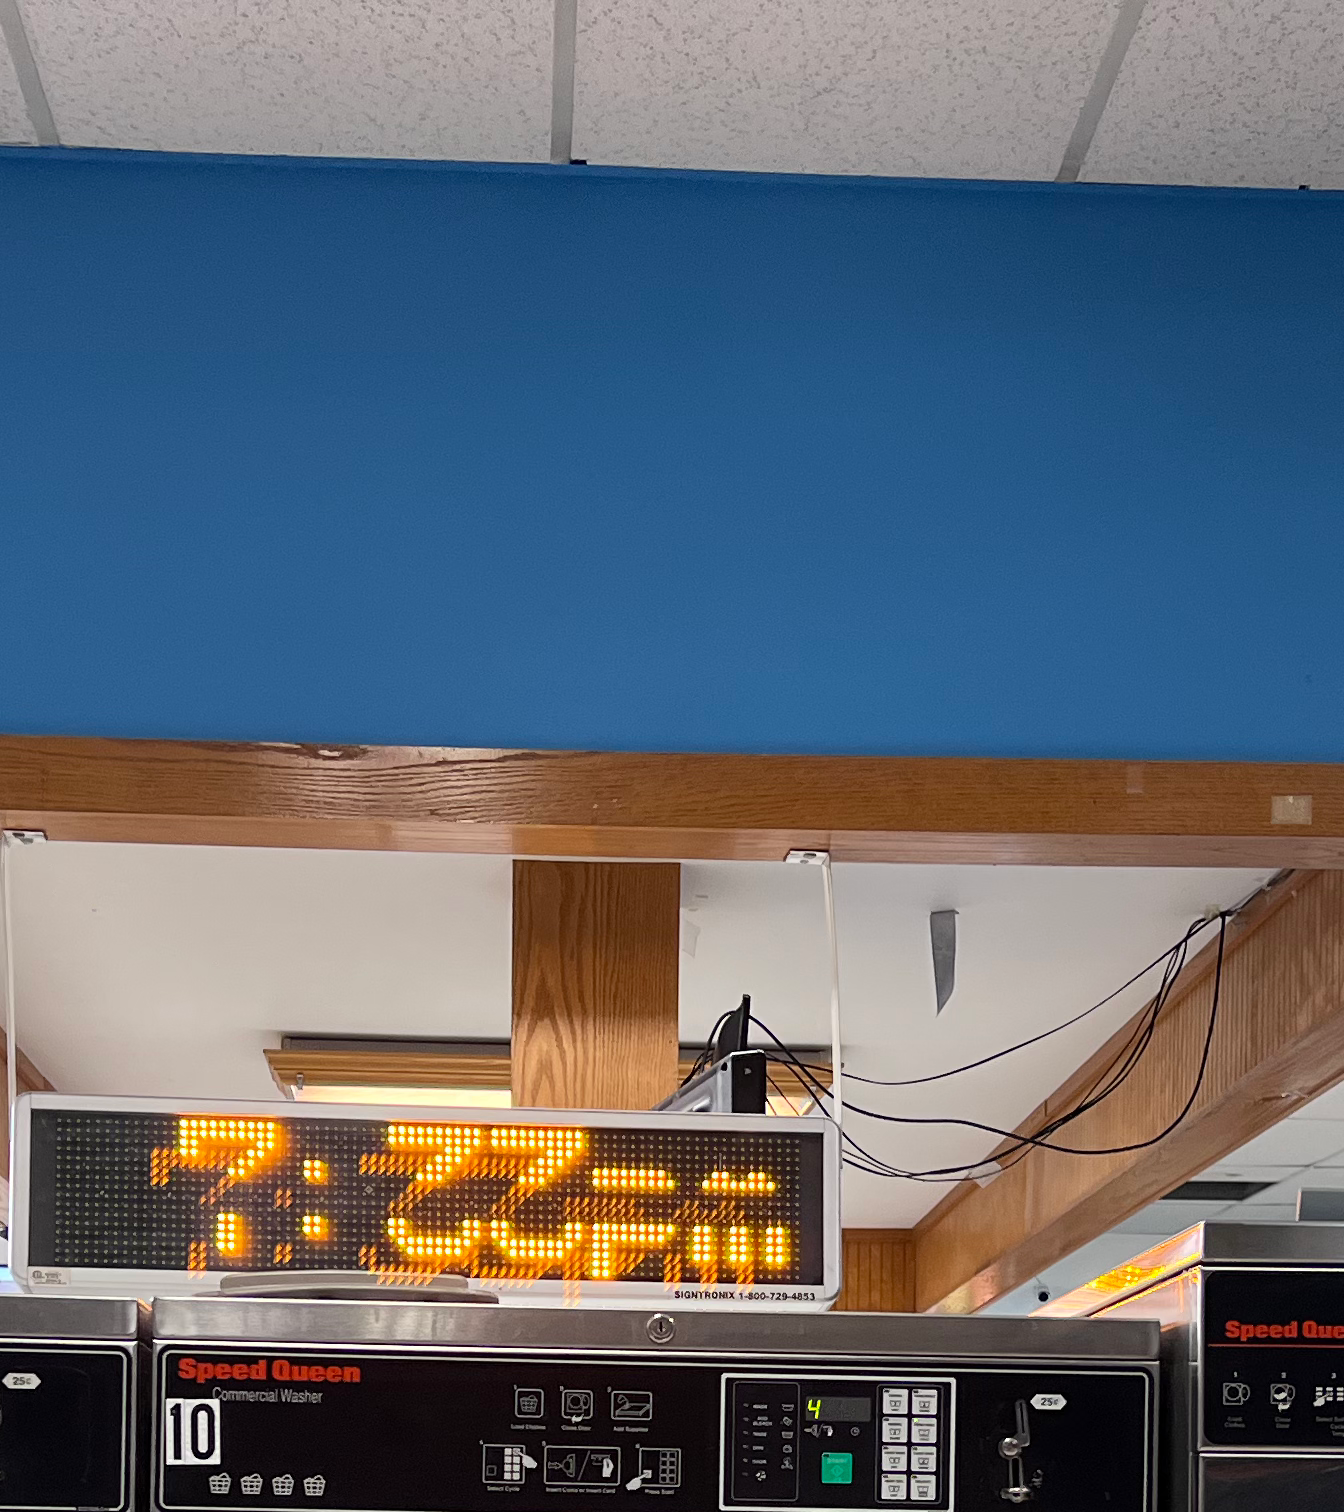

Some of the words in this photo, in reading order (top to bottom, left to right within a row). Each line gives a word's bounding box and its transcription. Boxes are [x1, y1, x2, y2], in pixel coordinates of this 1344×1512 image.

[674, 1290, 735, 1300] SIGNTRONIX
[738, 1291, 816, 1302] 1-800-729-4853
[1224, 1320, 1298, 1342] Speed
[177, 1357, 267, 1384] Speed
[271, 1359, 362, 1384] Queen
[212, 1386, 278, 1403] Commercial
[279, 1388, 324, 1404] Washer
[807, 1398, 823, 1420] 4
[168, 1401, 217, 1462] 10
